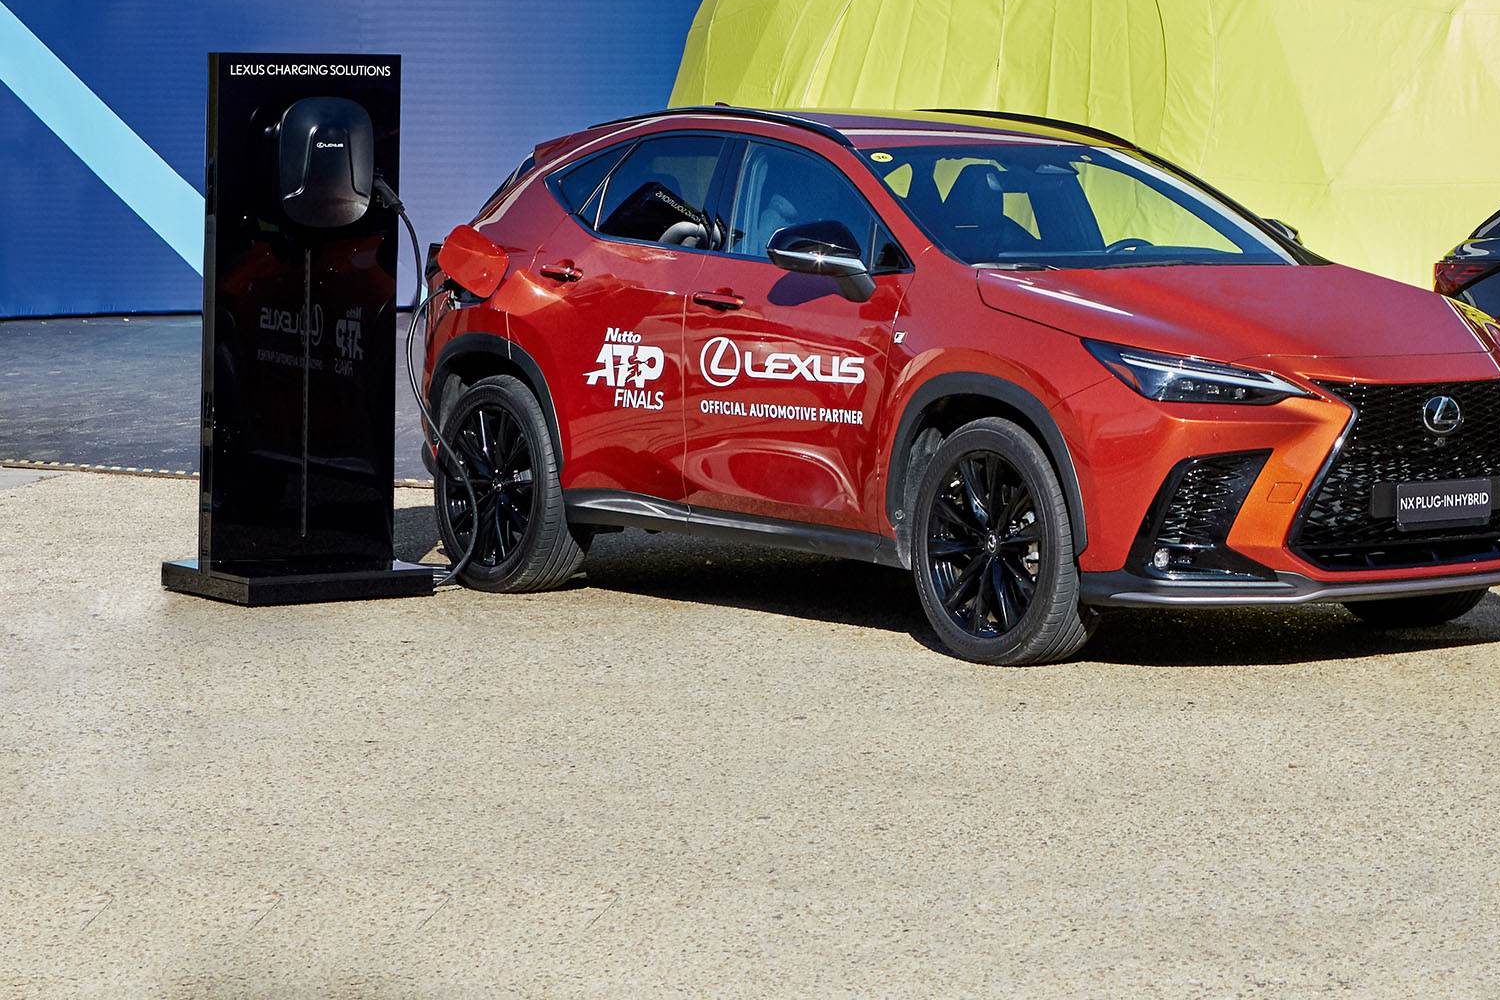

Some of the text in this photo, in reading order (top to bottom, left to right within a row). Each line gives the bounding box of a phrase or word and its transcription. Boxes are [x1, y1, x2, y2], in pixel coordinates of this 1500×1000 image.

[230, 64, 391, 77] LEXUS CHARGING SOLUTIONS
[604, 327, 642, 344] Nitto
[583, 343, 665, 389] ATP
[744, 351, 866, 385] LEXUS
[613, 388, 665, 411] FINALS
[700, 399, 864, 425] OFFICIAL AUTOMOTIVE PARTNER
[1400, 492, 1489, 510] NX PLUG-IN HYBRID
